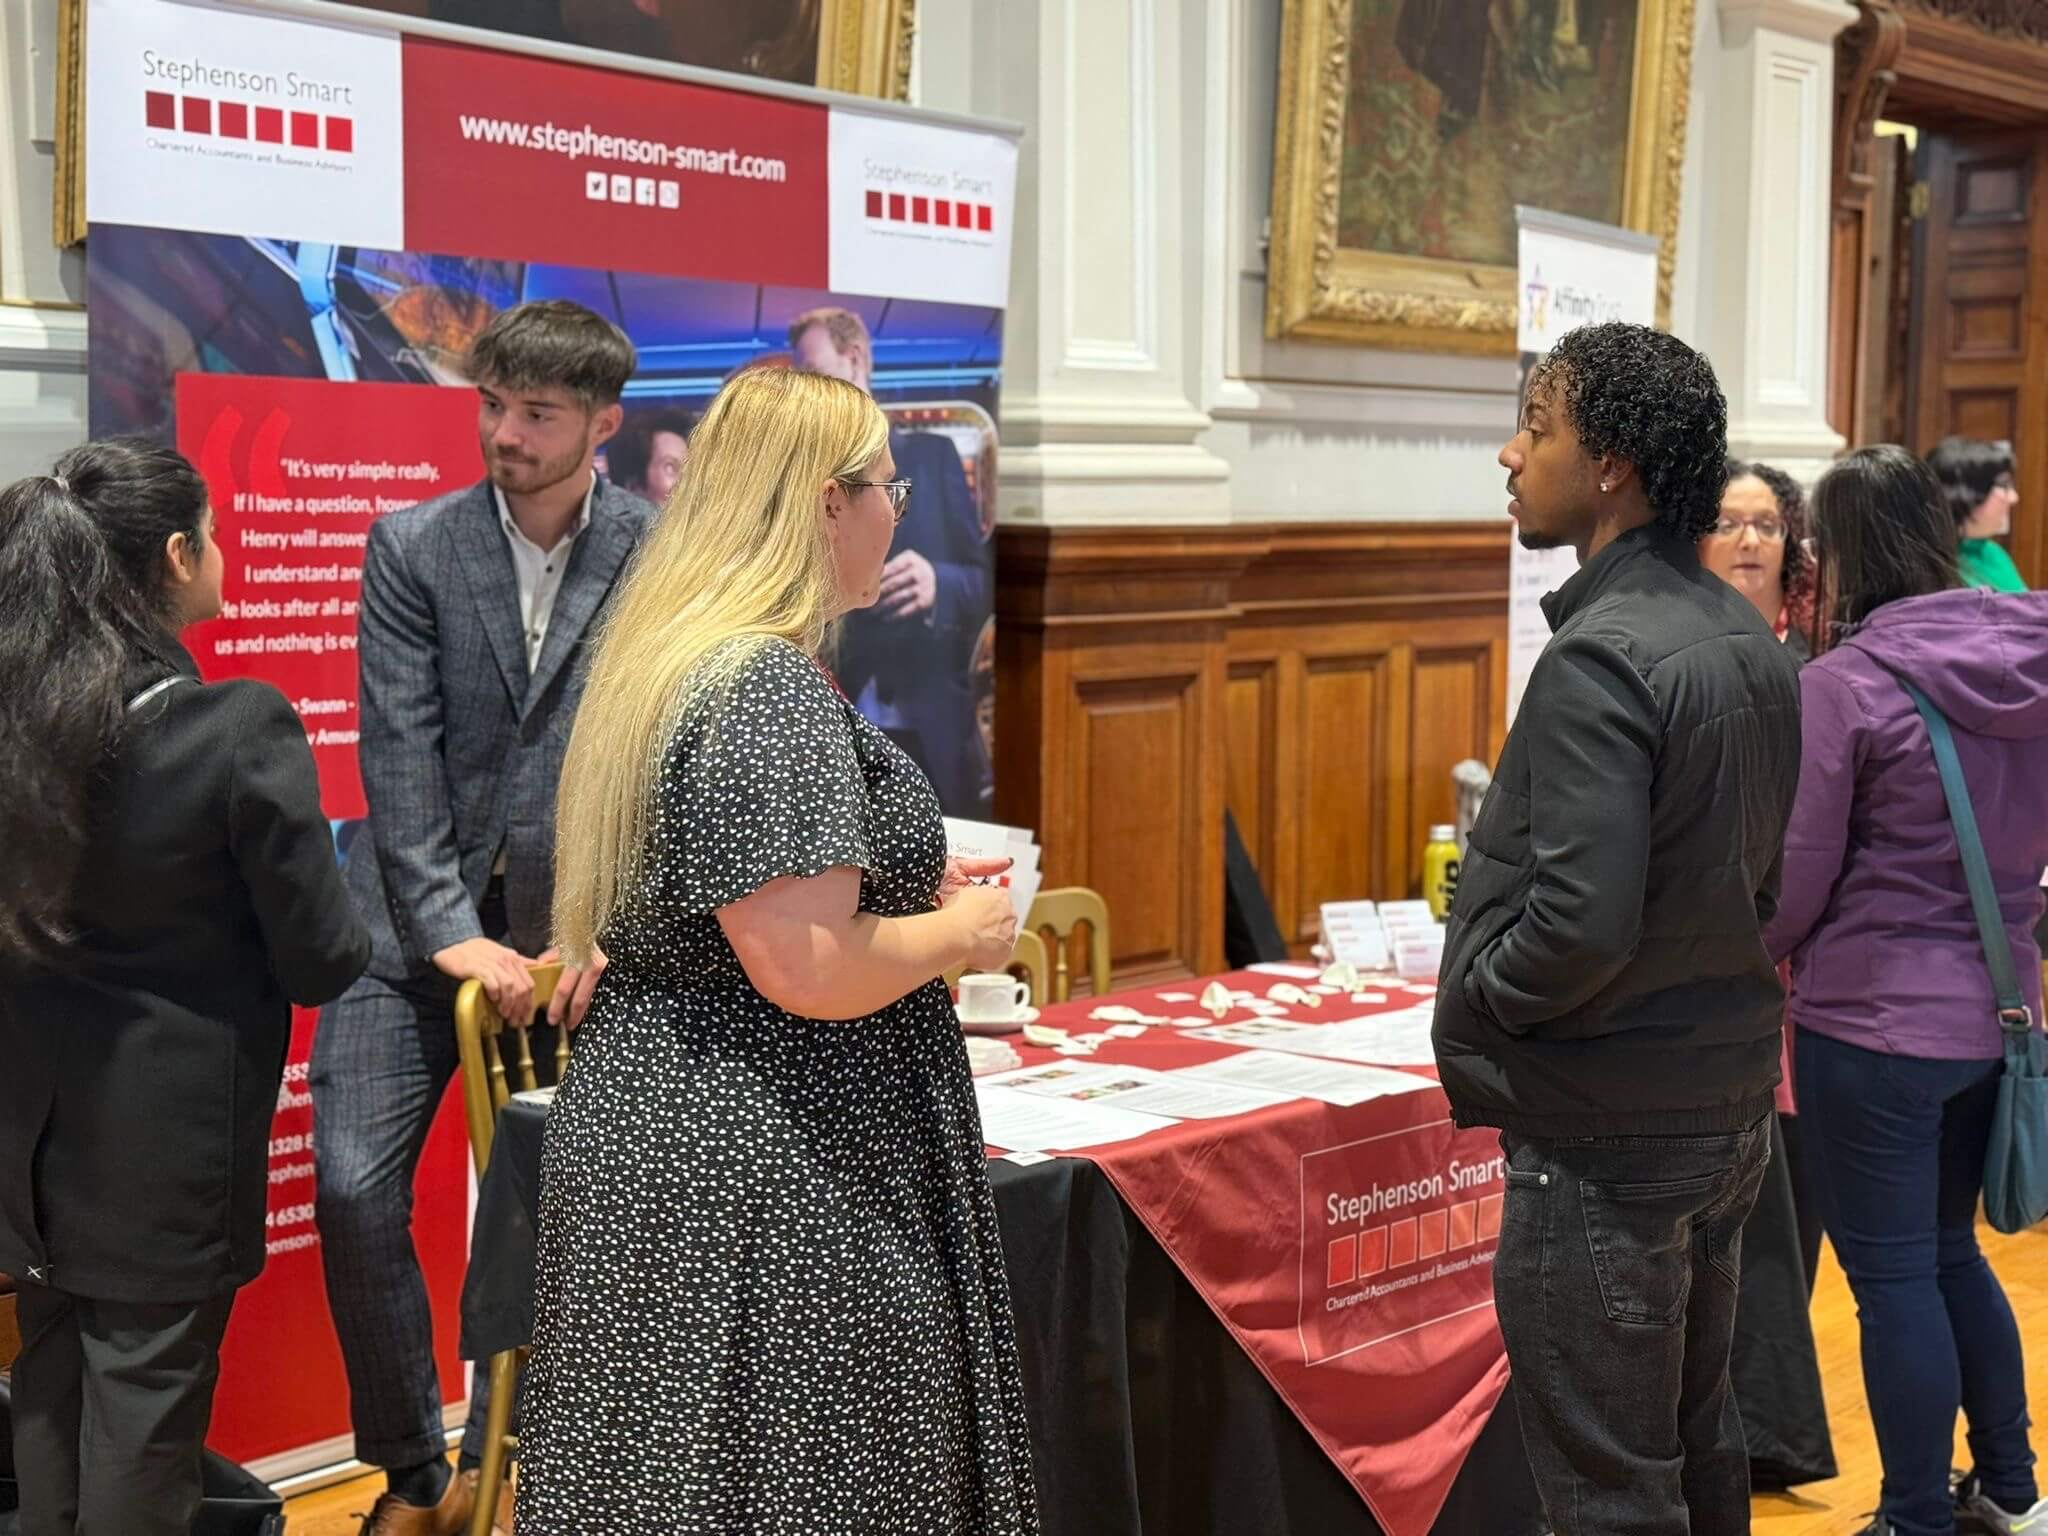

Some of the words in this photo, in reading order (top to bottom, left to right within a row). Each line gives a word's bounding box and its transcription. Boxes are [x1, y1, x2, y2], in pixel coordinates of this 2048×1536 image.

[143, 50, 278, 95] Stephenson
[286, 72, 353, 105] Smart
[459, 115, 787, 182] www.stephenson-smart.com
[312, 463, 346, 481] very
[348, 461, 396, 482] simple
[398, 462, 440, 483] really.
[233, 493, 246, 512] If
[255, 493, 293, 512] have
[294, 497, 304, 512] a
[306, 494, 374, 516] question,
[240, 528, 289, 551] Henry
[291, 528, 318, 547] will
[319, 532, 368, 548] answe
[244, 564, 251, 583] I
[253, 563, 338, 583] understand
[240, 598, 281, 619] looks
[283, 597, 320, 617] after
[321, 597, 339, 616] all
[214, 639, 234, 655] us
[235, 633, 265, 654] and
[266, 632, 323, 655] nothing
[324, 631, 338, 650] is
[339, 635, 359, 650] ev
[300, 696, 347, 715] Swann
[955, 843, 983, 857] Smart
[268, 1133, 303, 1157] 1328
[267, 1163, 316, 1185] ephen
[1327, 1174, 1443, 1227] Stephenson
[1448, 1155, 1505, 1192] Smart
[1326, 1287, 1369, 1312] Chartered
[1370, 1274, 1418, 1298] Accountants
[1420, 1266, 1435, 1282] and
[1436, 1259, 1468, 1278] Business
